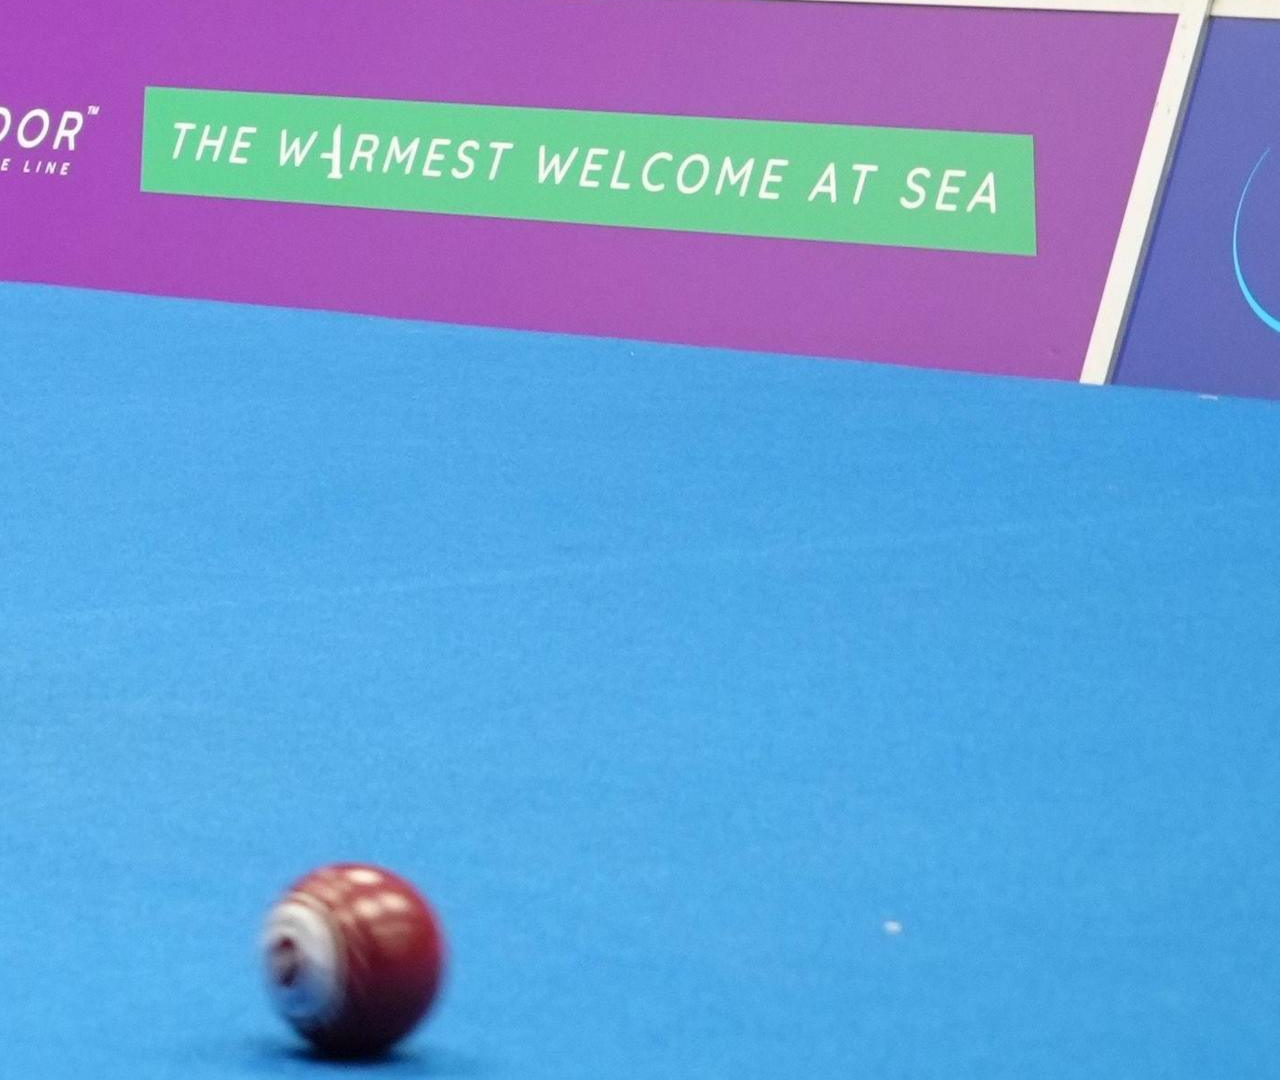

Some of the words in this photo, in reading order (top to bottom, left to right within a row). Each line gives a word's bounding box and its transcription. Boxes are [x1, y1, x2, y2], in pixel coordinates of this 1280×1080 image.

[23, 160, 71, 176] LINE
[172, 122, 258, 164] THE
[278, 126, 515, 181] WARMEST
[538, 145, 790, 201] WELCOME
[807, 162, 880, 205] AT
[899, 167, 998, 215] SEA
